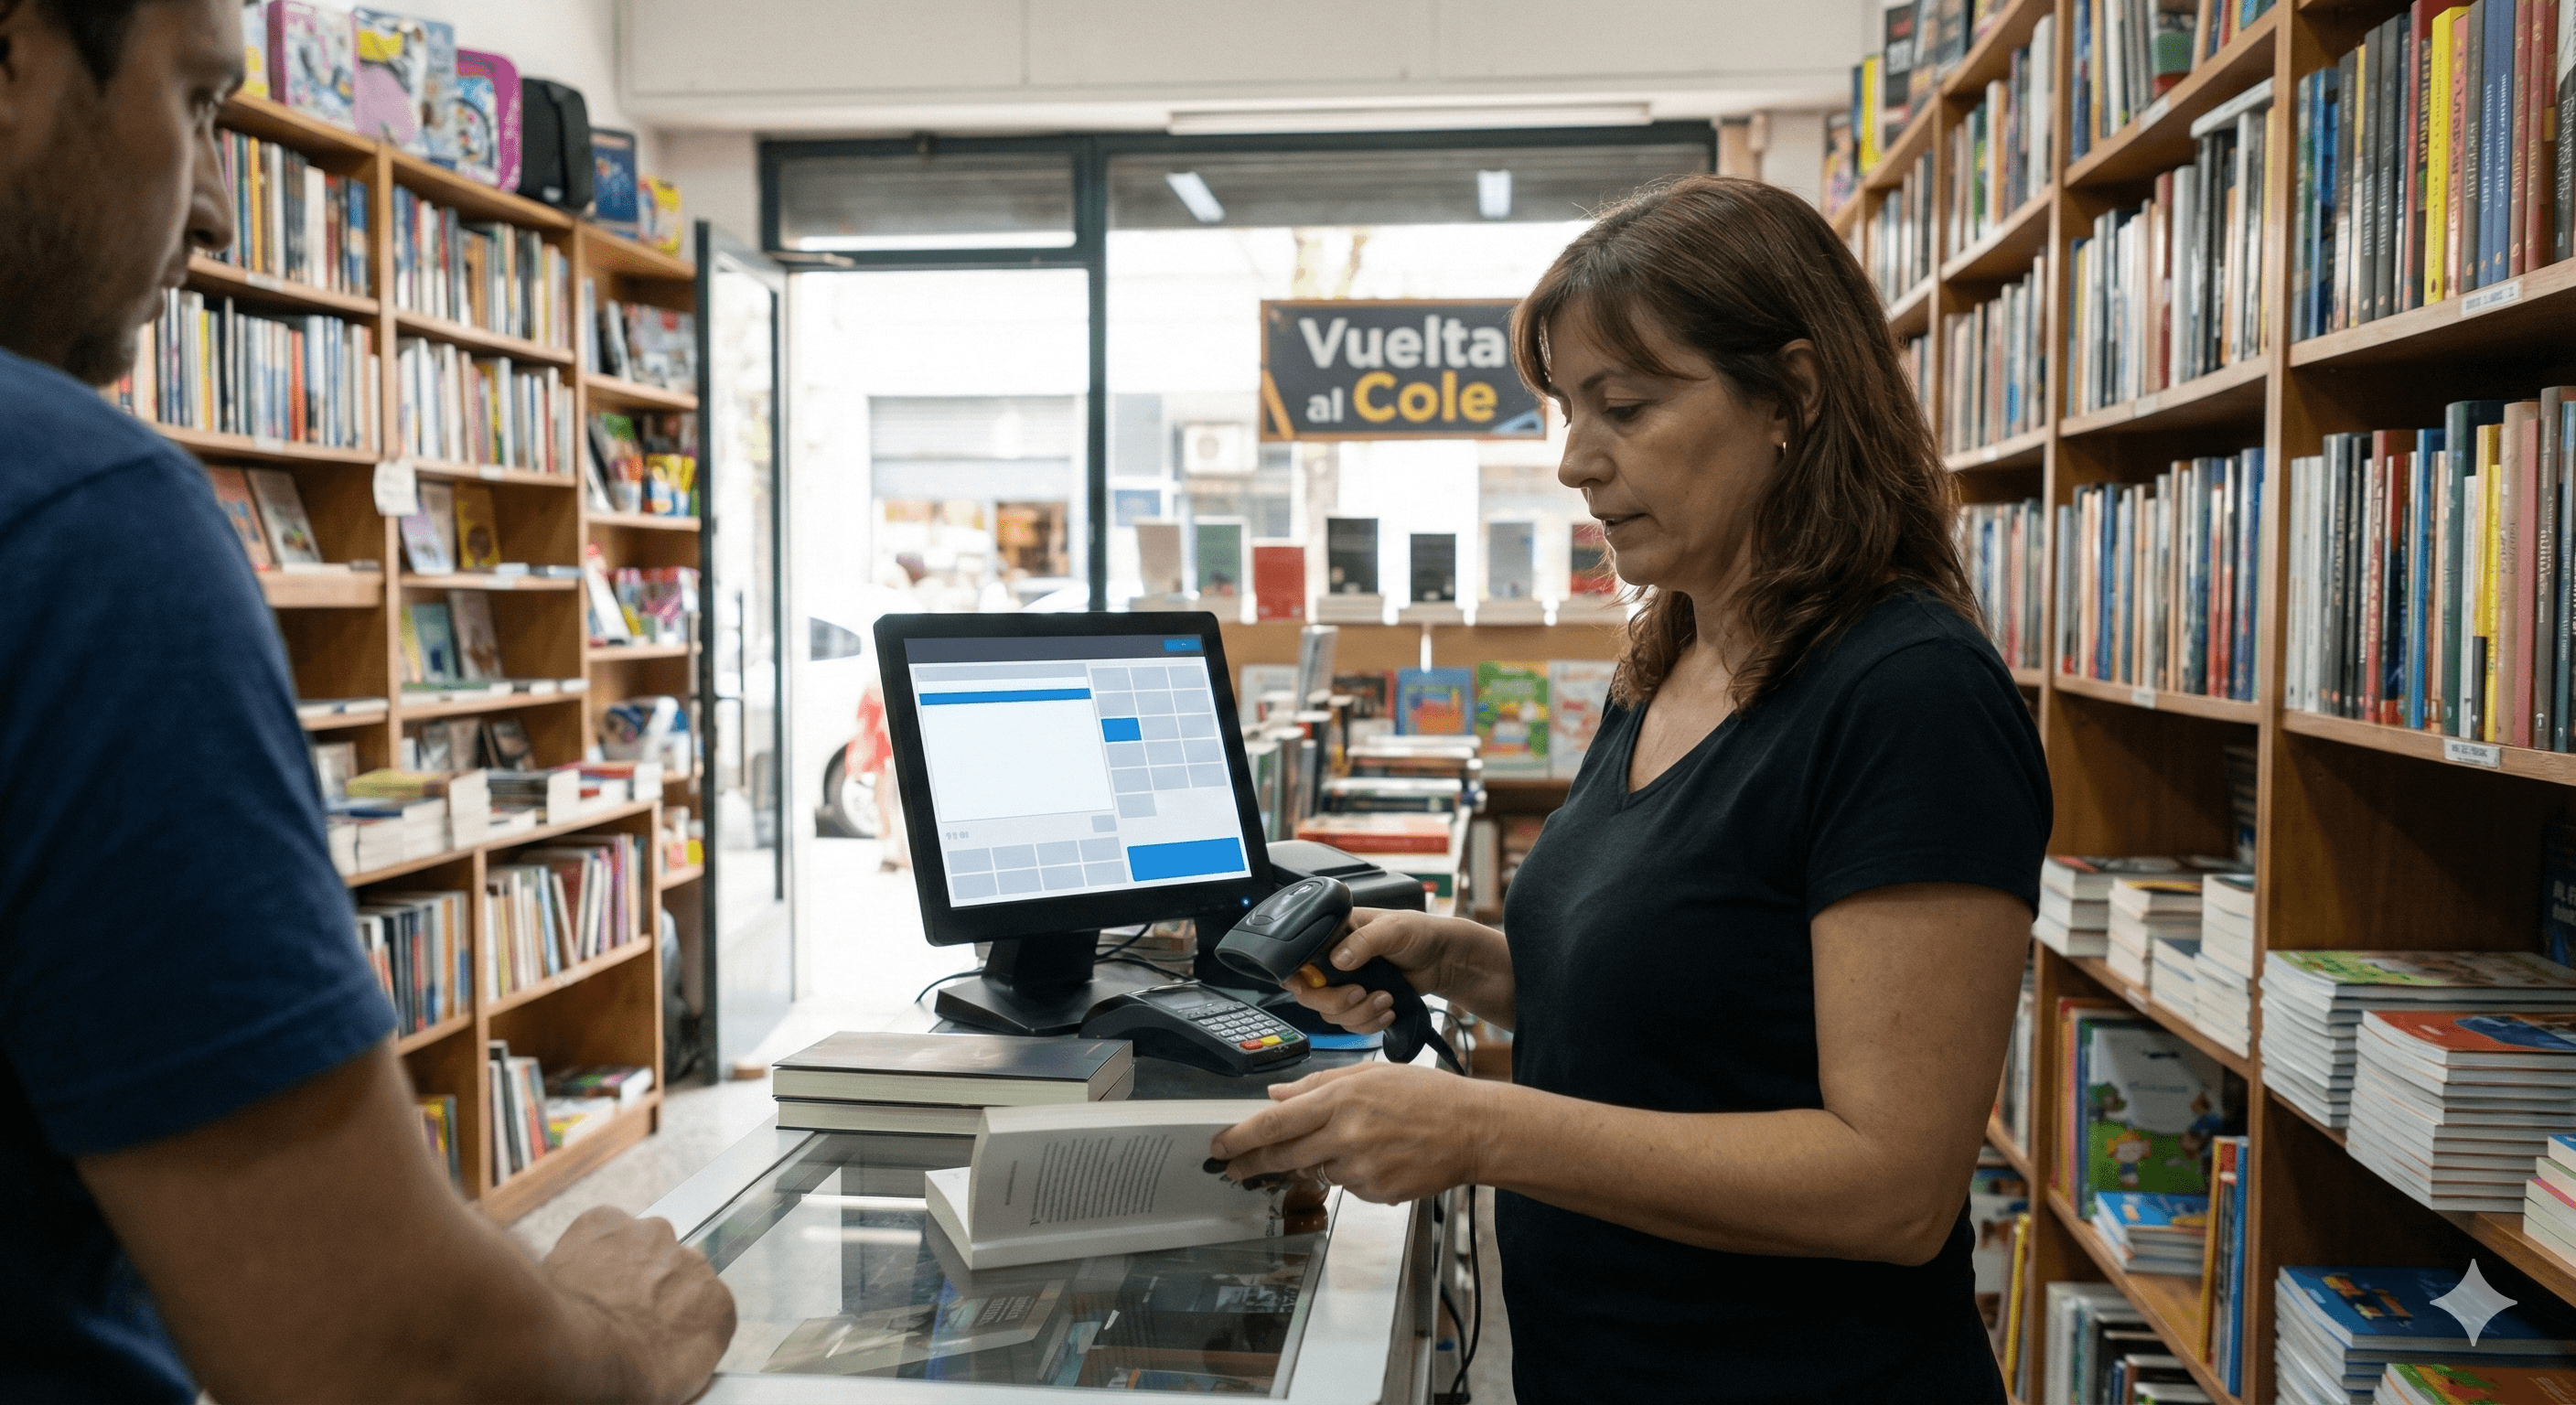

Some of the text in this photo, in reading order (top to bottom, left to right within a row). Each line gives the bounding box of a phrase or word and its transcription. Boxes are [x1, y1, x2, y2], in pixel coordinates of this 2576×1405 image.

[1298, 315, 1507, 369] Vuelta
[1307, 370, 1497, 424] al Cole
